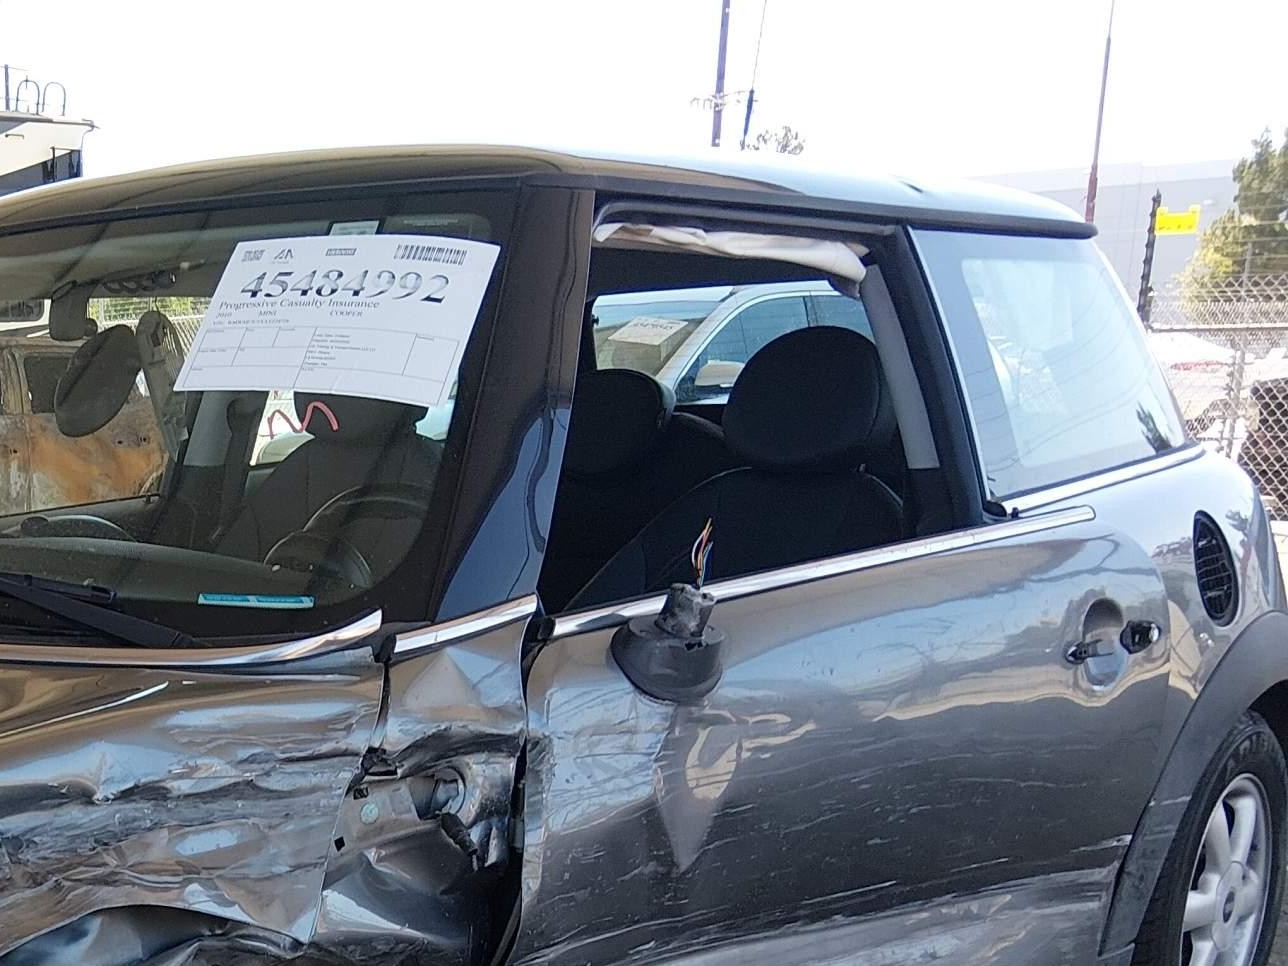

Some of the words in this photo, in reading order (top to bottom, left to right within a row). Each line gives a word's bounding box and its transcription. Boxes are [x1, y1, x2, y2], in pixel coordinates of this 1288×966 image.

[241, 270, 449, 303] 45484992
[219, 301, 277, 310] Progressive
[279, 299, 324, 308] Casualty
[328, 300, 380, 309] Insurance
